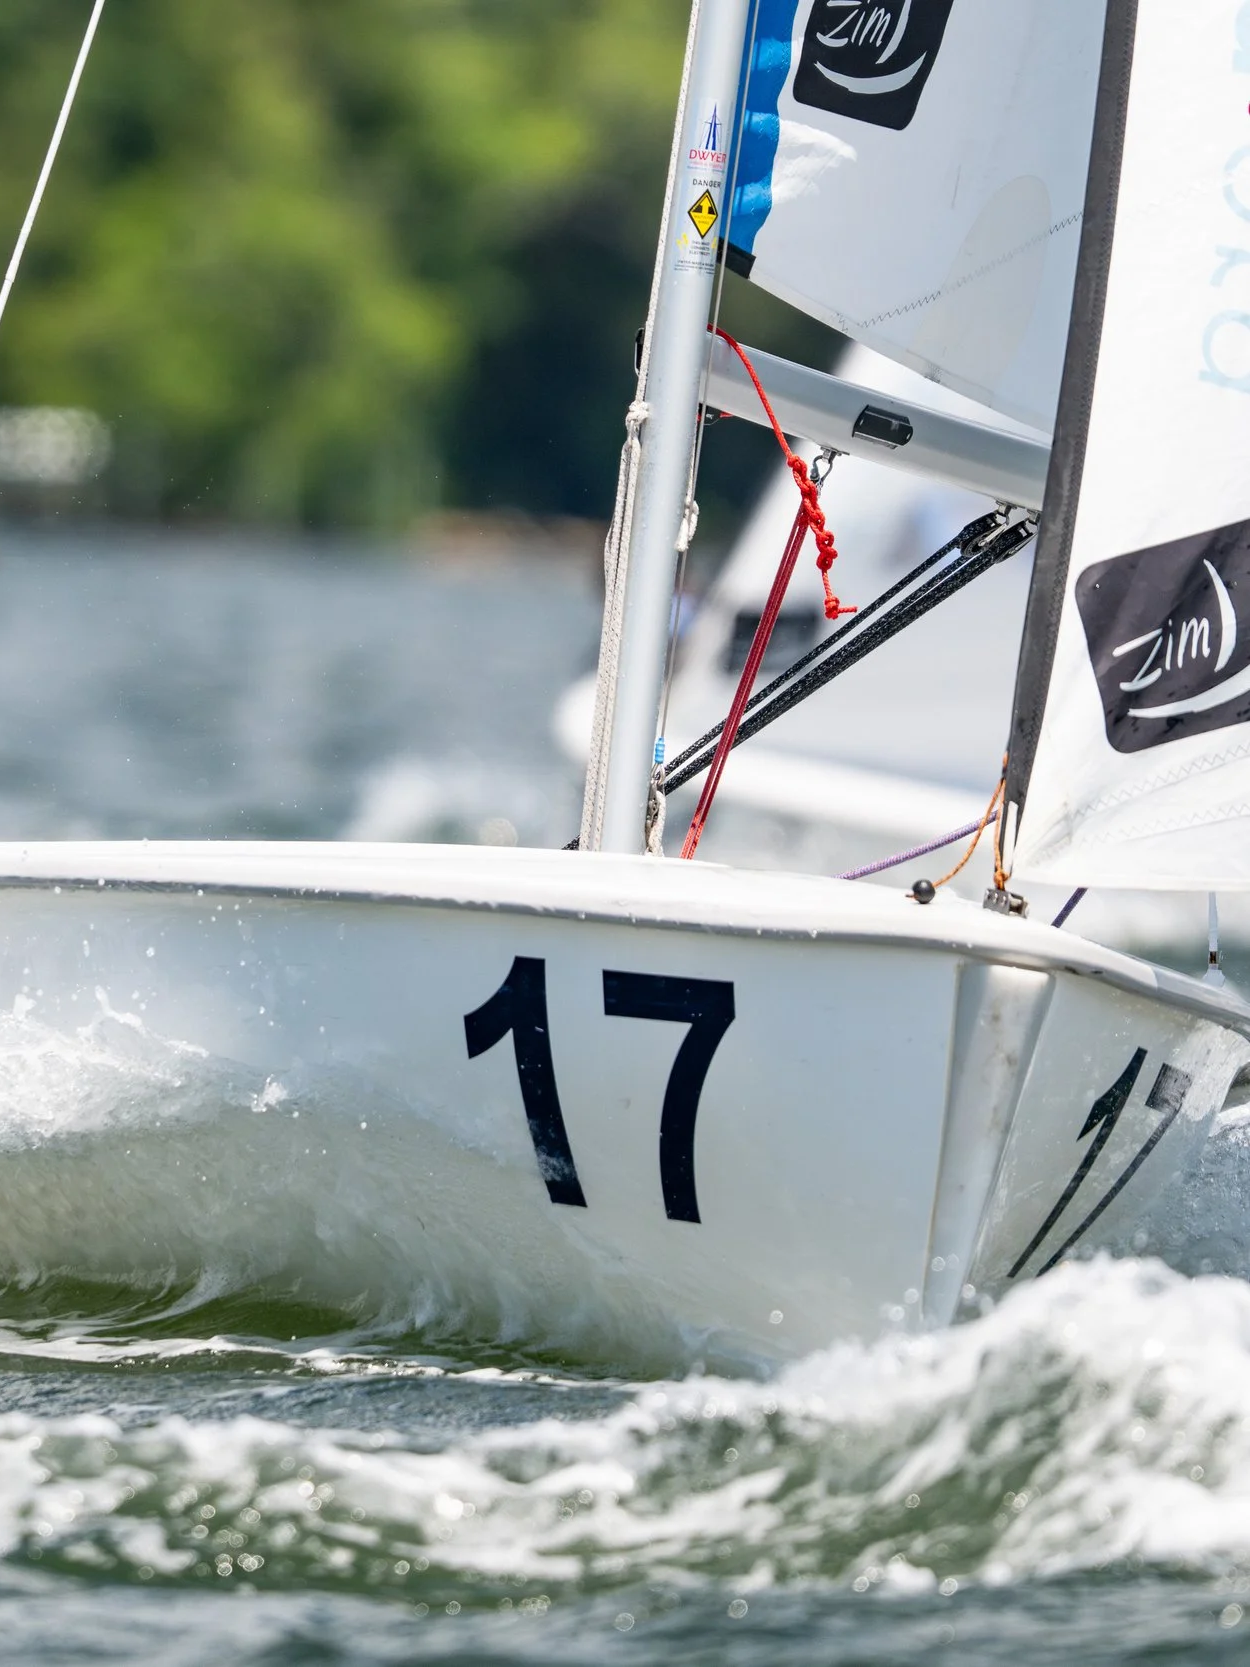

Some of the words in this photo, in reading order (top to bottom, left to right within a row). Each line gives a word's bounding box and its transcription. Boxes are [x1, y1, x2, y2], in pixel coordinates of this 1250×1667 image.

[688, 149, 727, 163] DWYER
[692, 178, 721, 188] DANGER
[463, 955, 736, 1224] 17
[1006, 1046, 1193, 1278] 17
